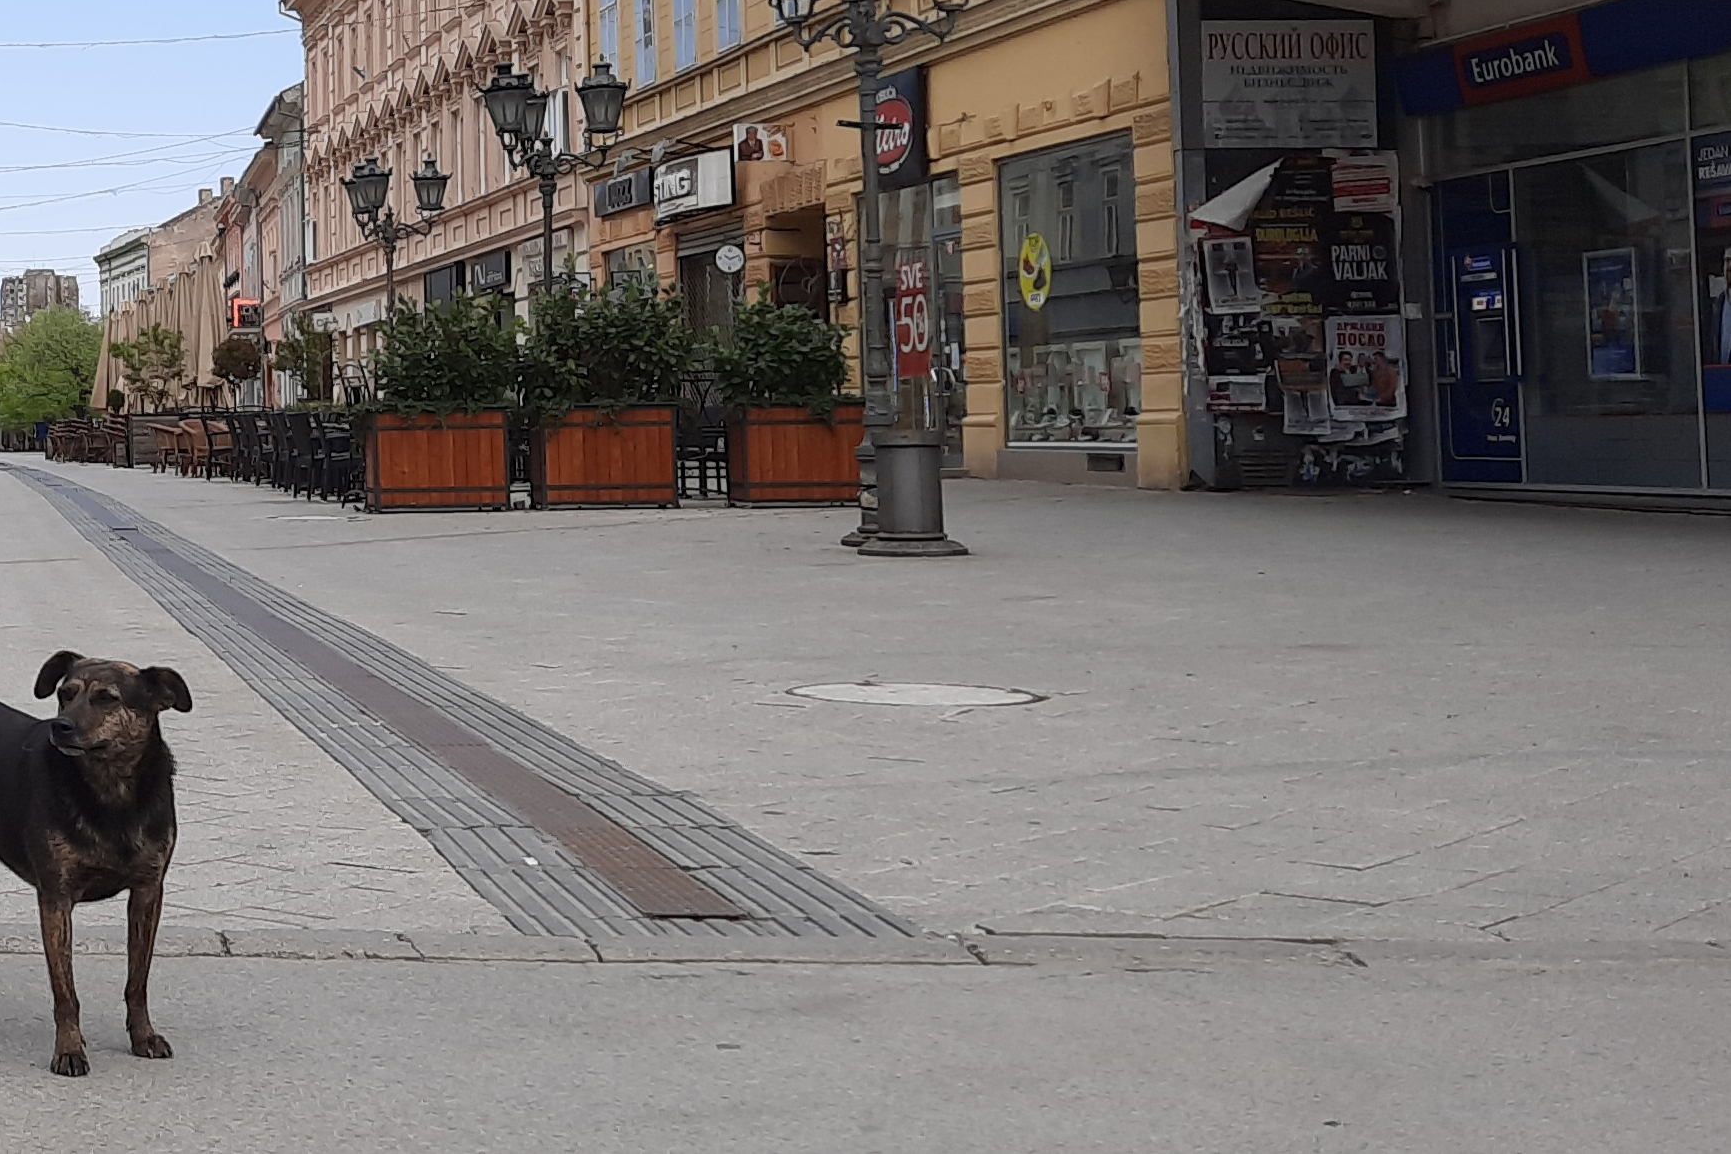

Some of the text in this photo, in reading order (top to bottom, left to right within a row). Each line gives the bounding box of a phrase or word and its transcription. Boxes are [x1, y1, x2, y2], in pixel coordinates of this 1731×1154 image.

[1208, 27, 1368, 59] РУССКИЙ ОФИС
[1470, 39, 1559, 84] Eurobank
[1697, 145, 1729, 162] JEDAN
[1331, 245, 1371, 261] PARNI
[900, 262, 923, 291] SVE
[1332, 260, 1389, 281] VALJAK
